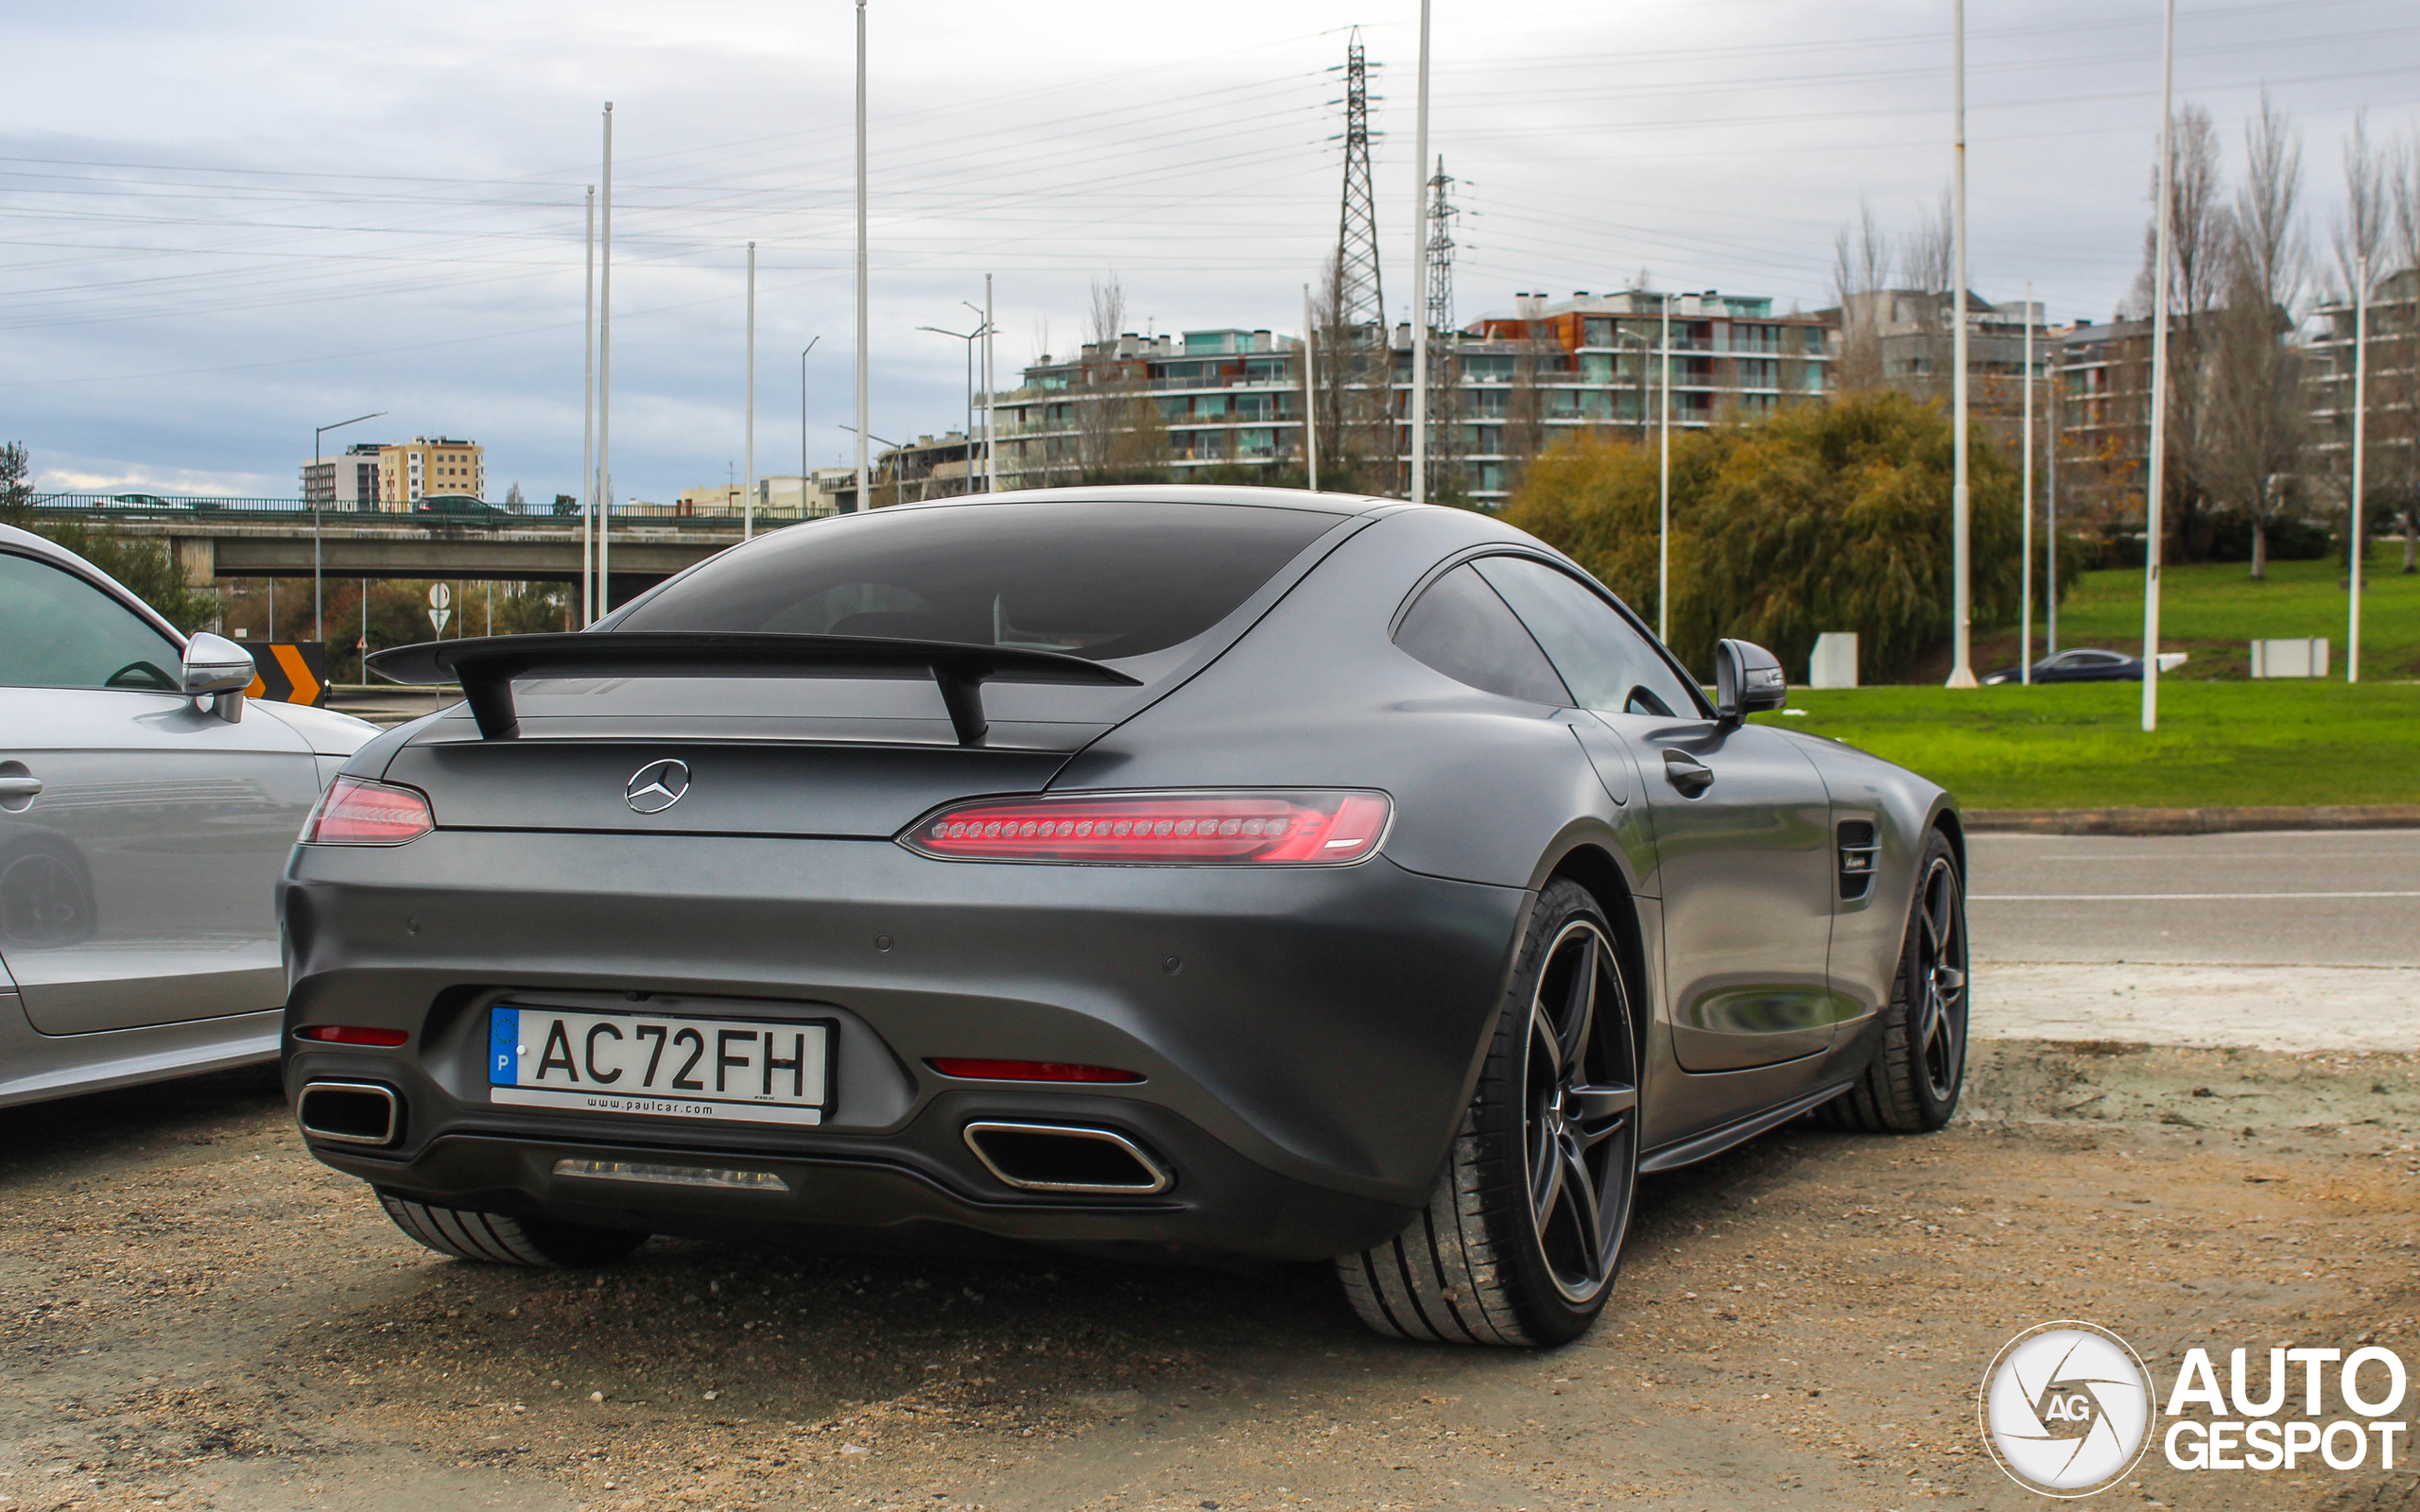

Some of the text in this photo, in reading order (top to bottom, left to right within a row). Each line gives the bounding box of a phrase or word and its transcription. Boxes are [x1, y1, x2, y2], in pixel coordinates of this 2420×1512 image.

[497, 1055, 510, 1072] P
[535, 1019, 805, 1097] AC72FH
[587, 1097, 713, 1115] www.paulcar.com
